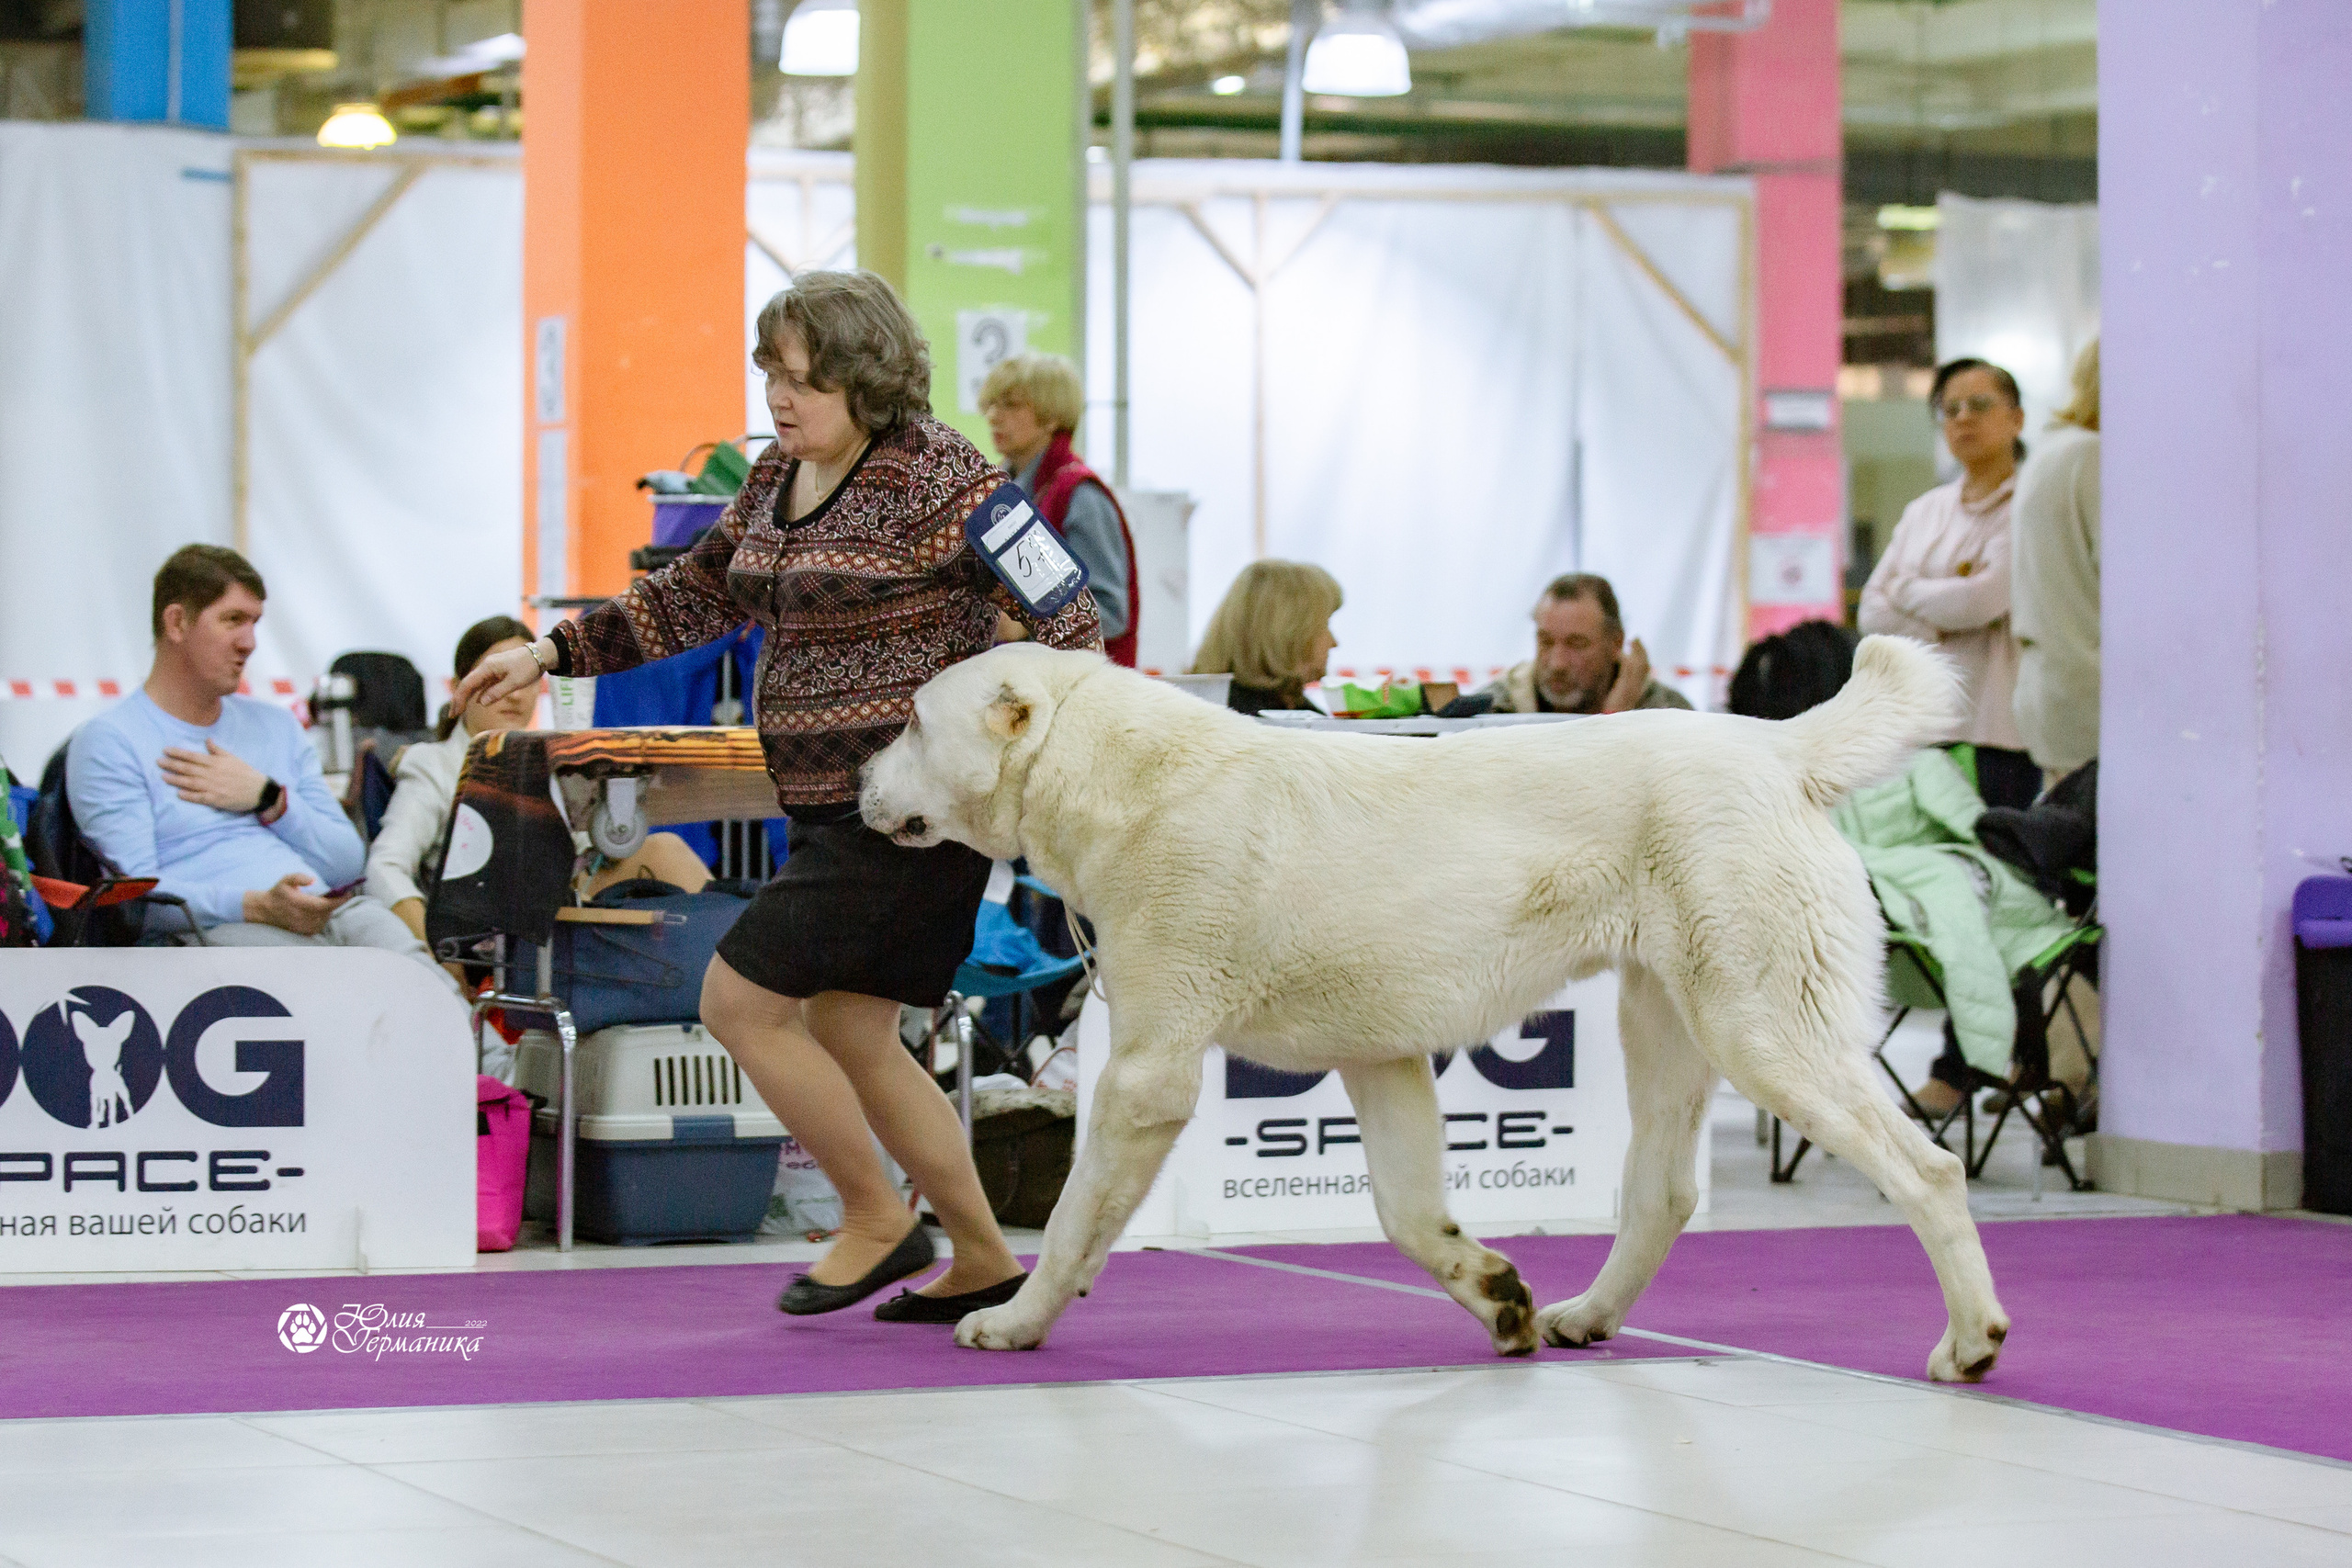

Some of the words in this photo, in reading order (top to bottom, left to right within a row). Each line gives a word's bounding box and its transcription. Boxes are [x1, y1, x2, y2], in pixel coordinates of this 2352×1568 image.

[0, 985, 305, 1129] OG
[1225, 1111, 1574, 1157] -SPCE-
[1224, 1172, 1370, 1199] вселенная
[1479, 1160, 1576, 1189] собаки
[0, 1214, 57, 1236] ная
[69, 1206, 176, 1235] вашей
[188, 1204, 306, 1235] собаки
